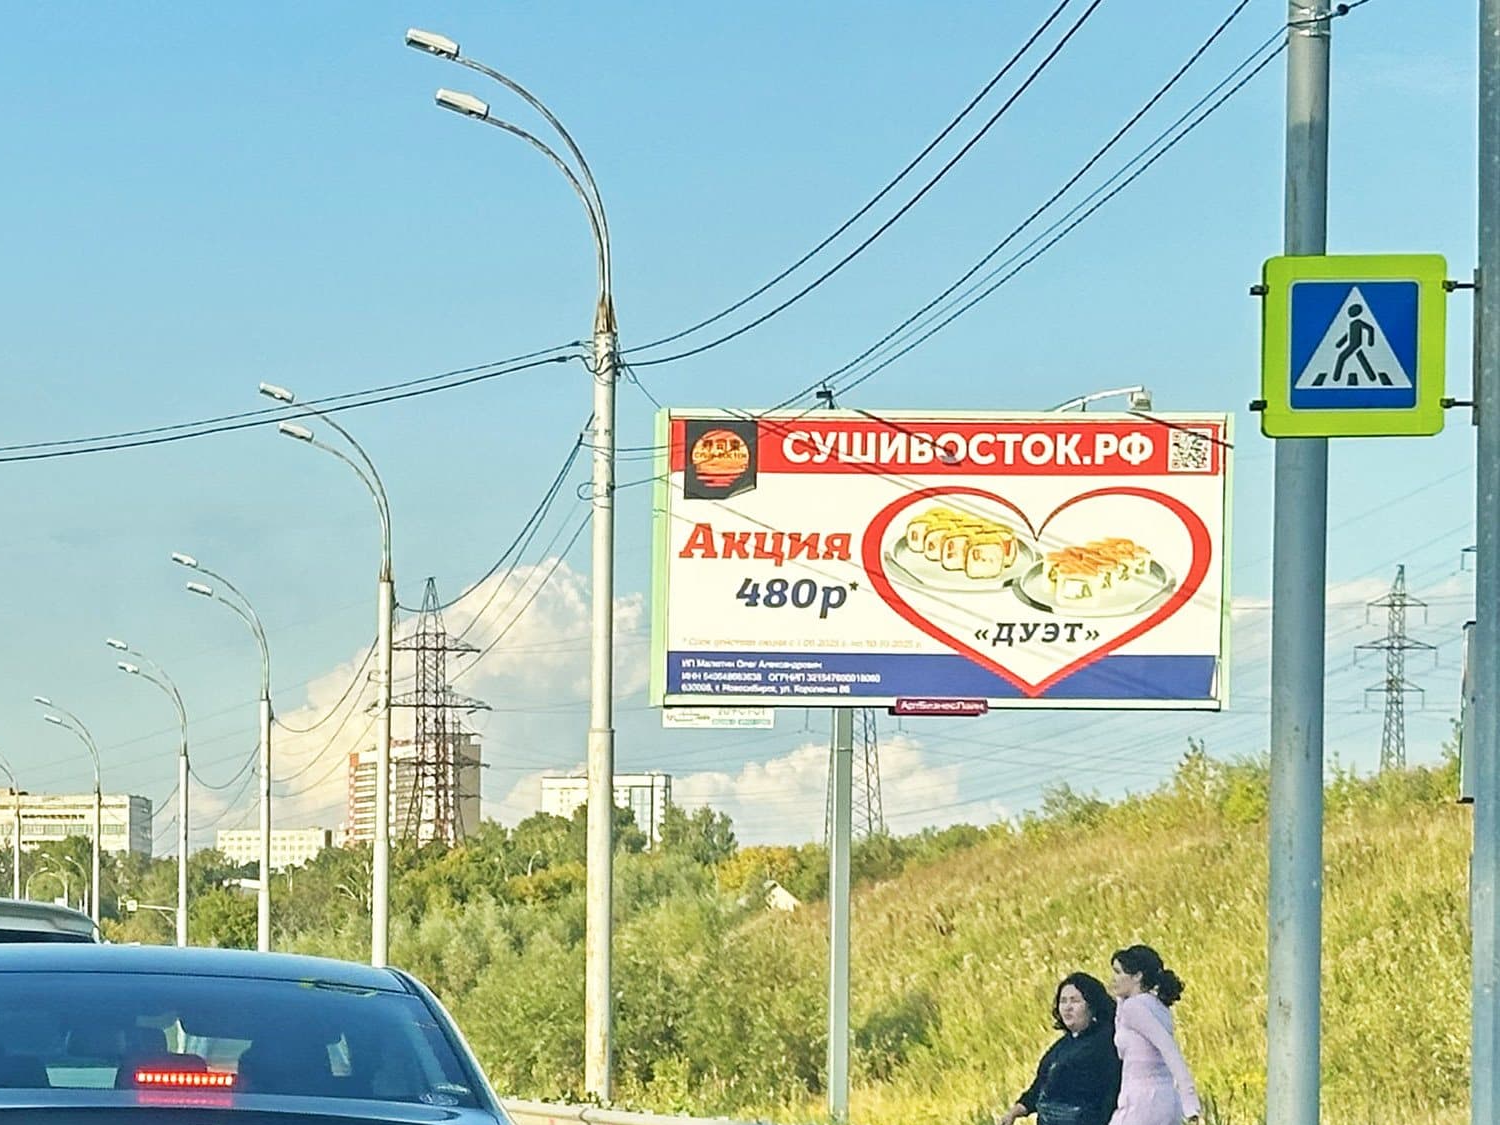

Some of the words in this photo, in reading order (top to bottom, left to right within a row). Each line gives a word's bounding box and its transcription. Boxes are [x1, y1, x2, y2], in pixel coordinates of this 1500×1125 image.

[782, 430, 1154, 465] СУШИВОСТОК.РФ
[678, 522, 852, 567] Акция
[974, 622, 1100, 647] «ДУЭТ»
